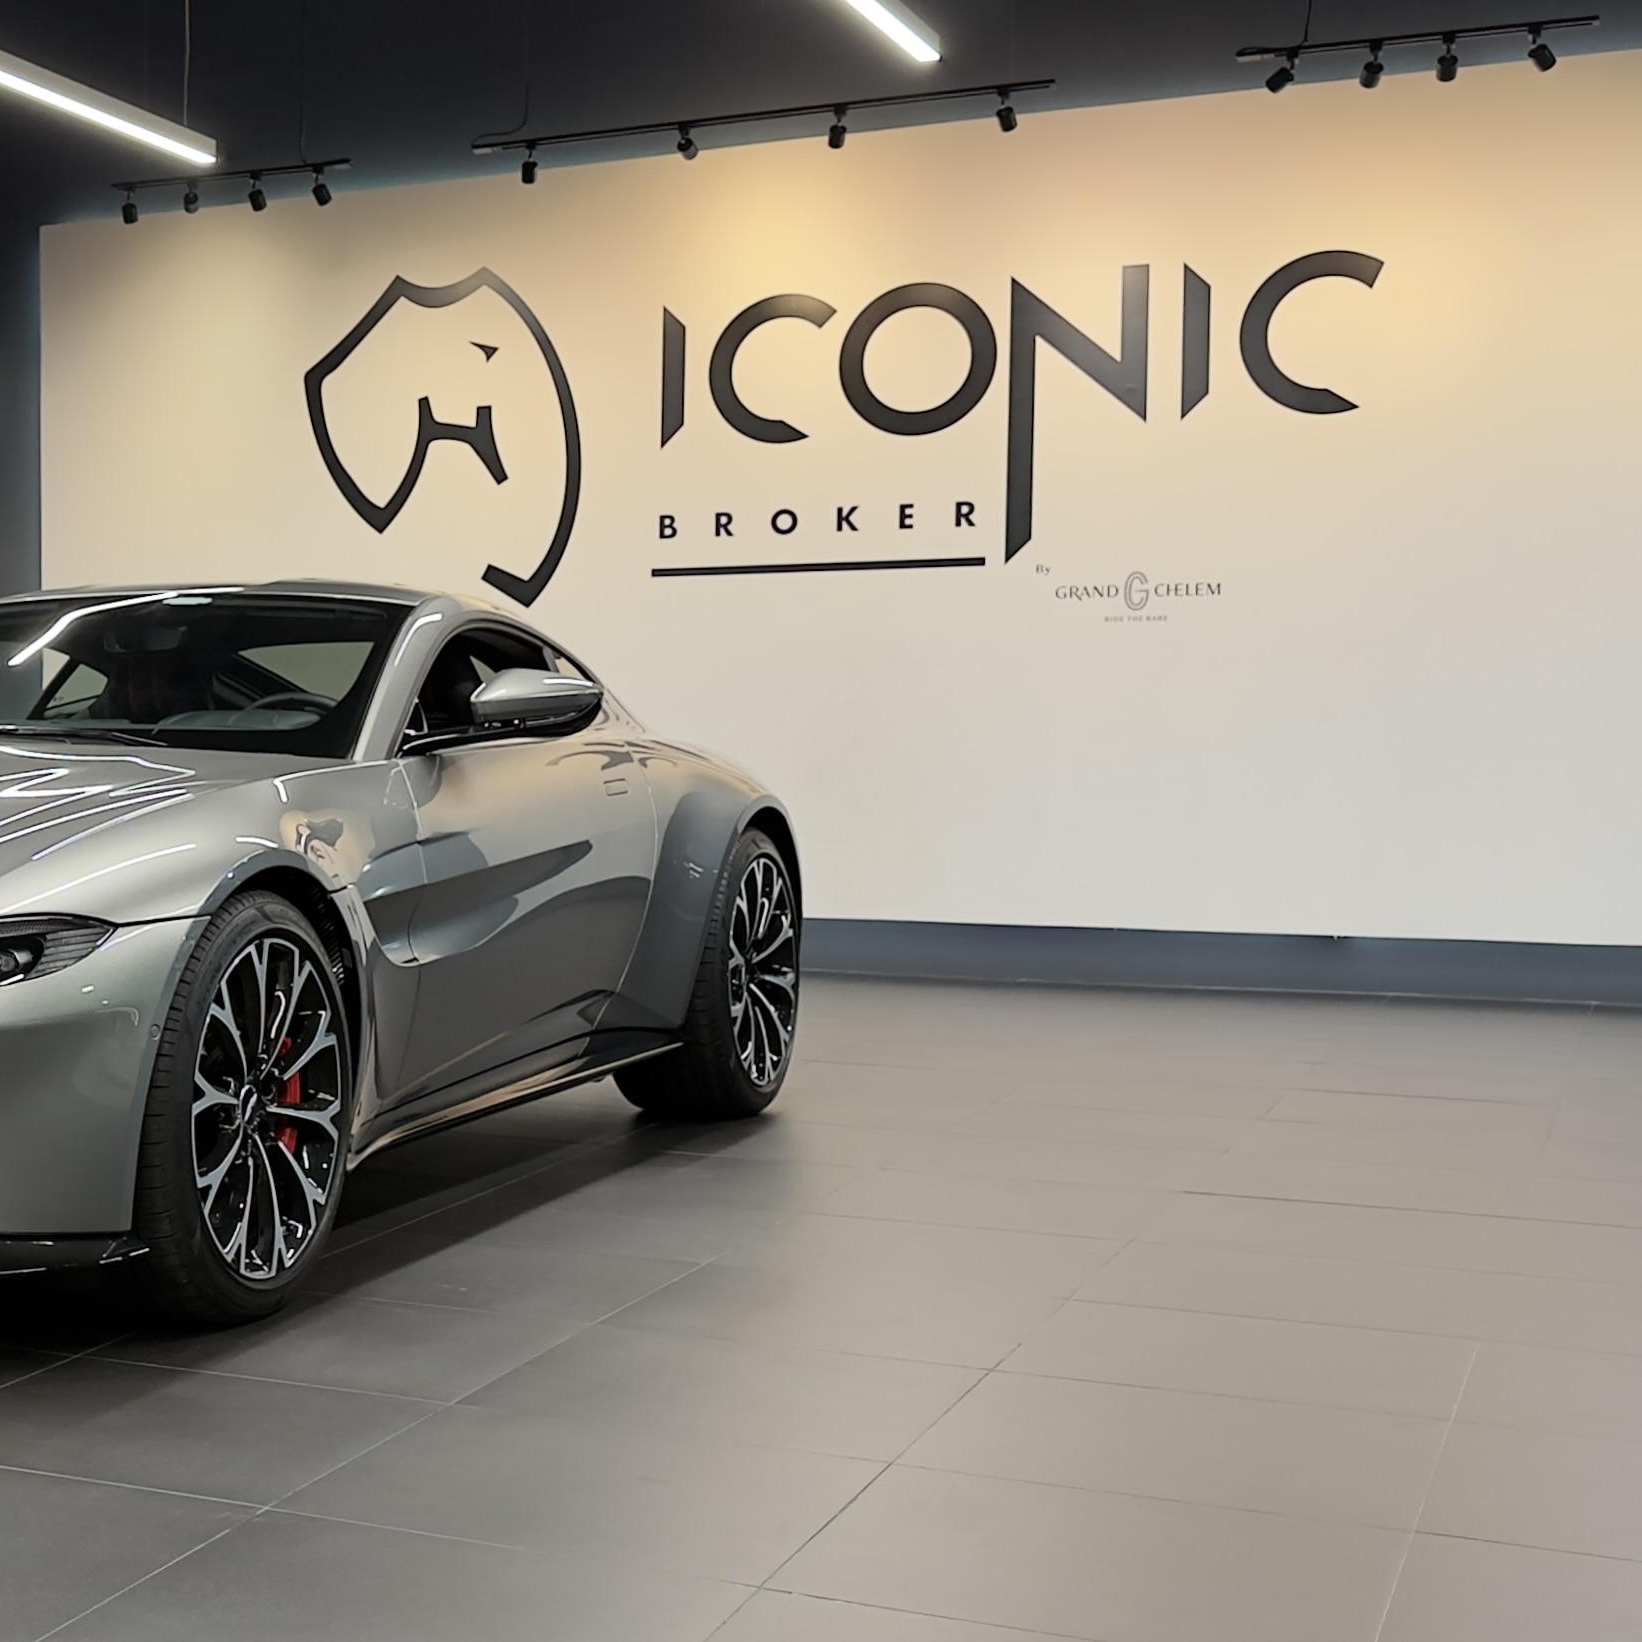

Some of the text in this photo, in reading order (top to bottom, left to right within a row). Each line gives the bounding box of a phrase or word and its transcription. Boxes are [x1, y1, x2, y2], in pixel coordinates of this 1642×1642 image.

[660, 250, 1384, 564] ICONIC
[658, 501, 976, 540] BROKER
[1035, 564, 1051, 576] By
[1055, 584, 1119, 601] GRAND
[1154, 582, 1222, 597] CHELEM
